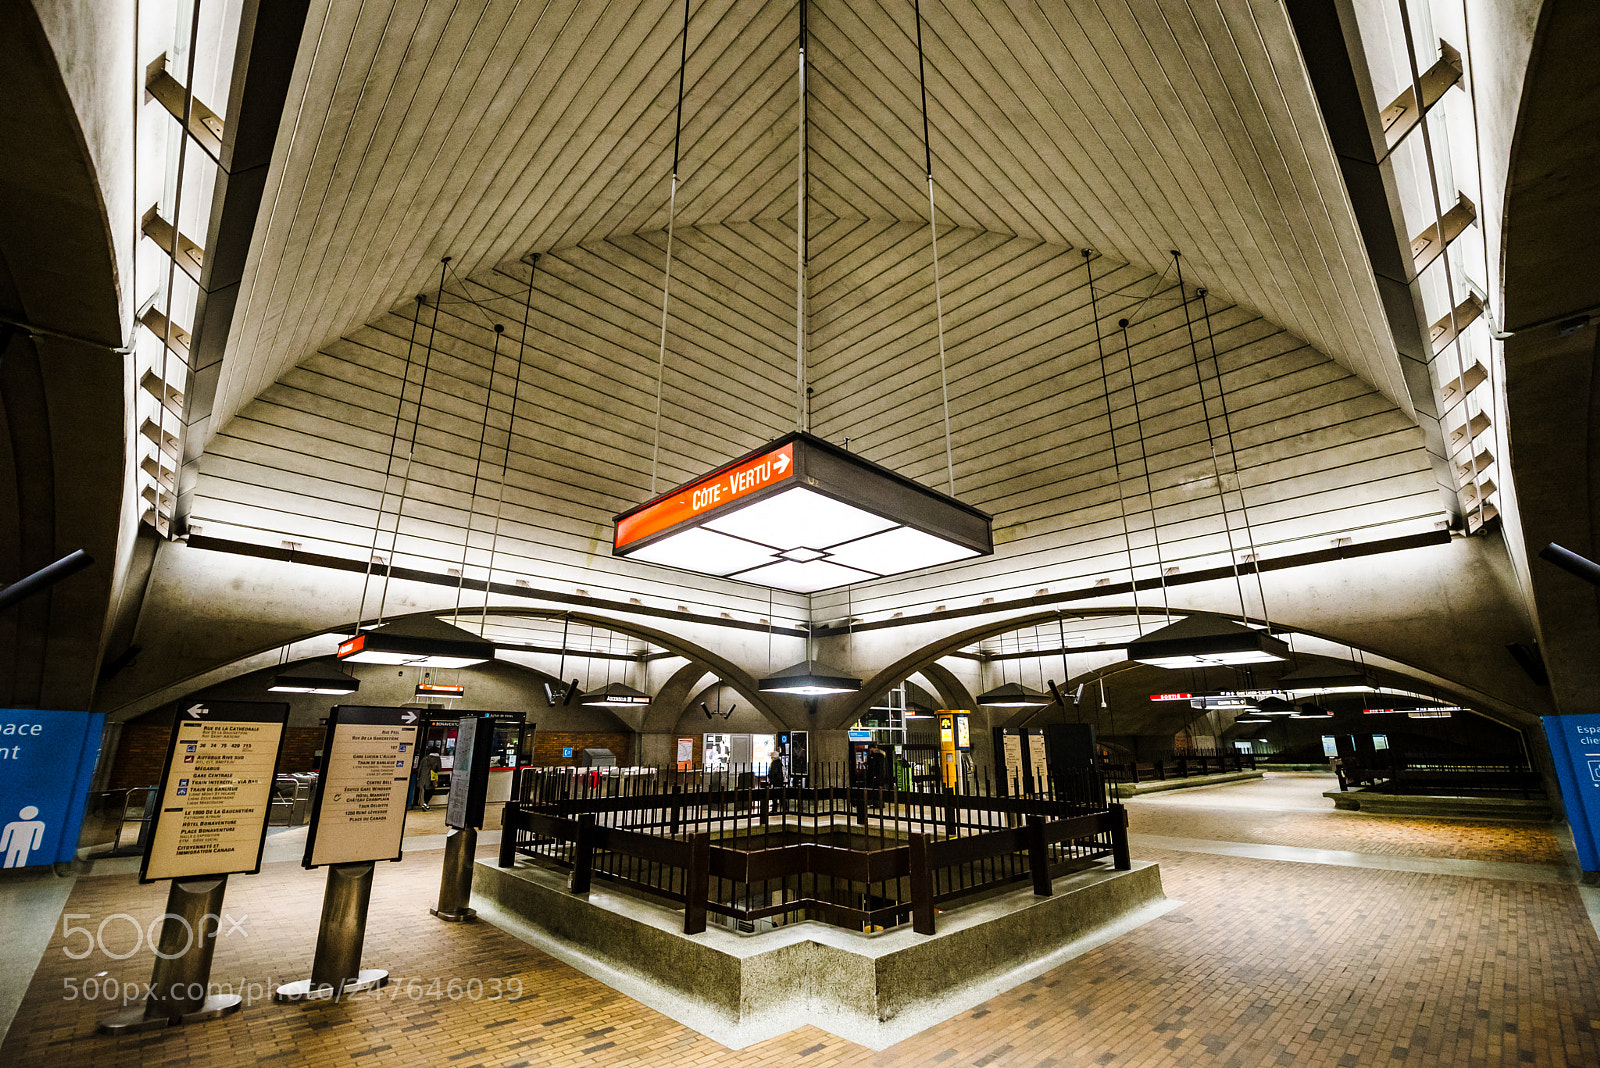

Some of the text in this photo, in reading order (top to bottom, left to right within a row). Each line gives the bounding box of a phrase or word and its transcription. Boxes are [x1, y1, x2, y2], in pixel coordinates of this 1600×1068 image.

[692, 483, 721, 511] CÔTE
[729, 461, 771, 495] VERTU
[0, 723, 42, 736] ace
